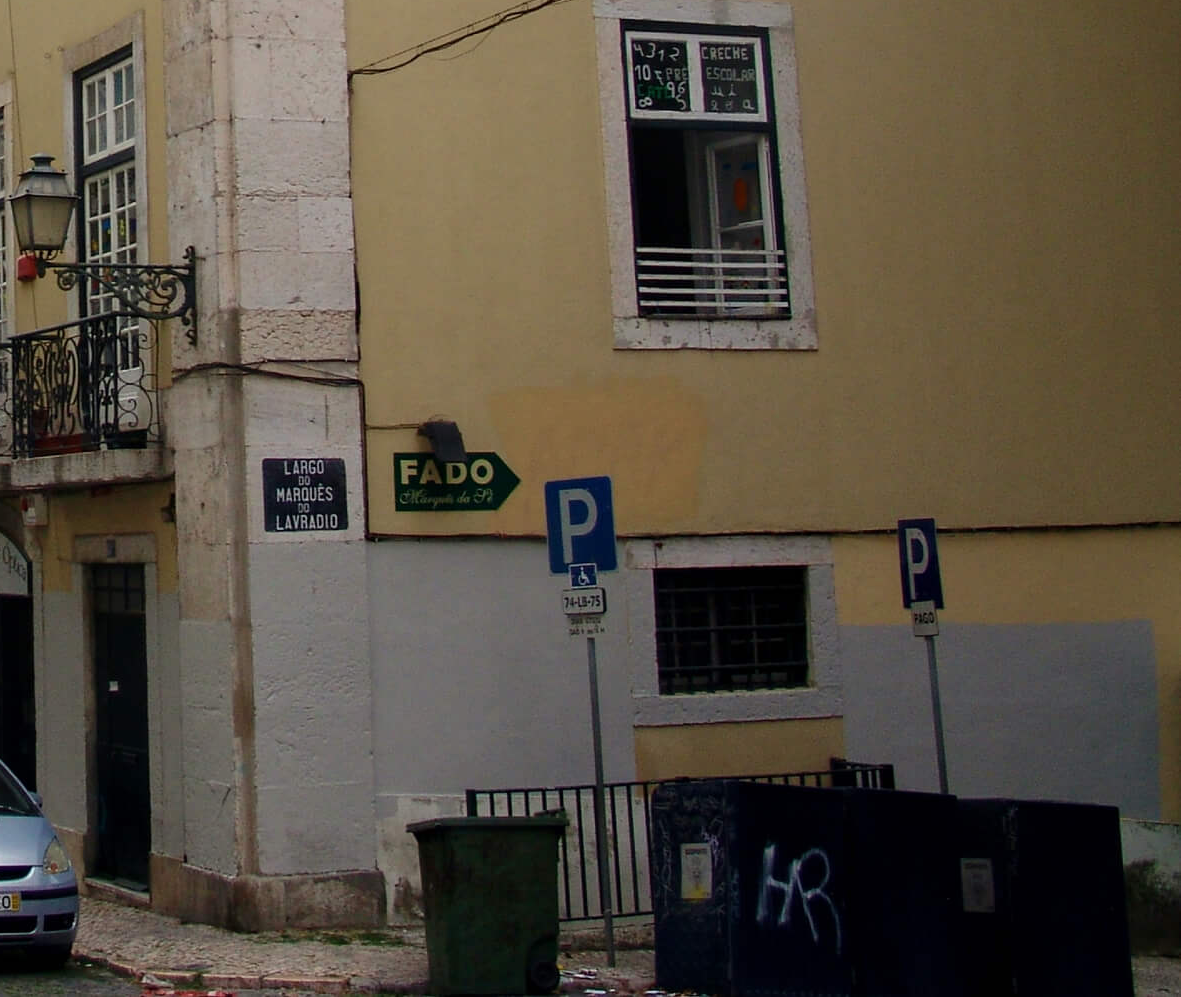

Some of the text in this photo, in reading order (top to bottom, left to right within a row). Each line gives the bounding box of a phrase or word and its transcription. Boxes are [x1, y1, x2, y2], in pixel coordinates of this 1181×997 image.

[701, 46, 749, 61] CRECHE
[706, 66, 755, 82] ESCOLAR
[284, 459, 325, 475] LARGO
[399, 458, 495, 485] FADO
[298, 475, 311, 486] DO
[276, 482, 333, 503] MARQUÊS
[297, 503, 311, 513] DO
[275, 513, 338, 530] LAVRADIO
[558, 488, 598, 564] P
[905, 527, 930, 600] P
